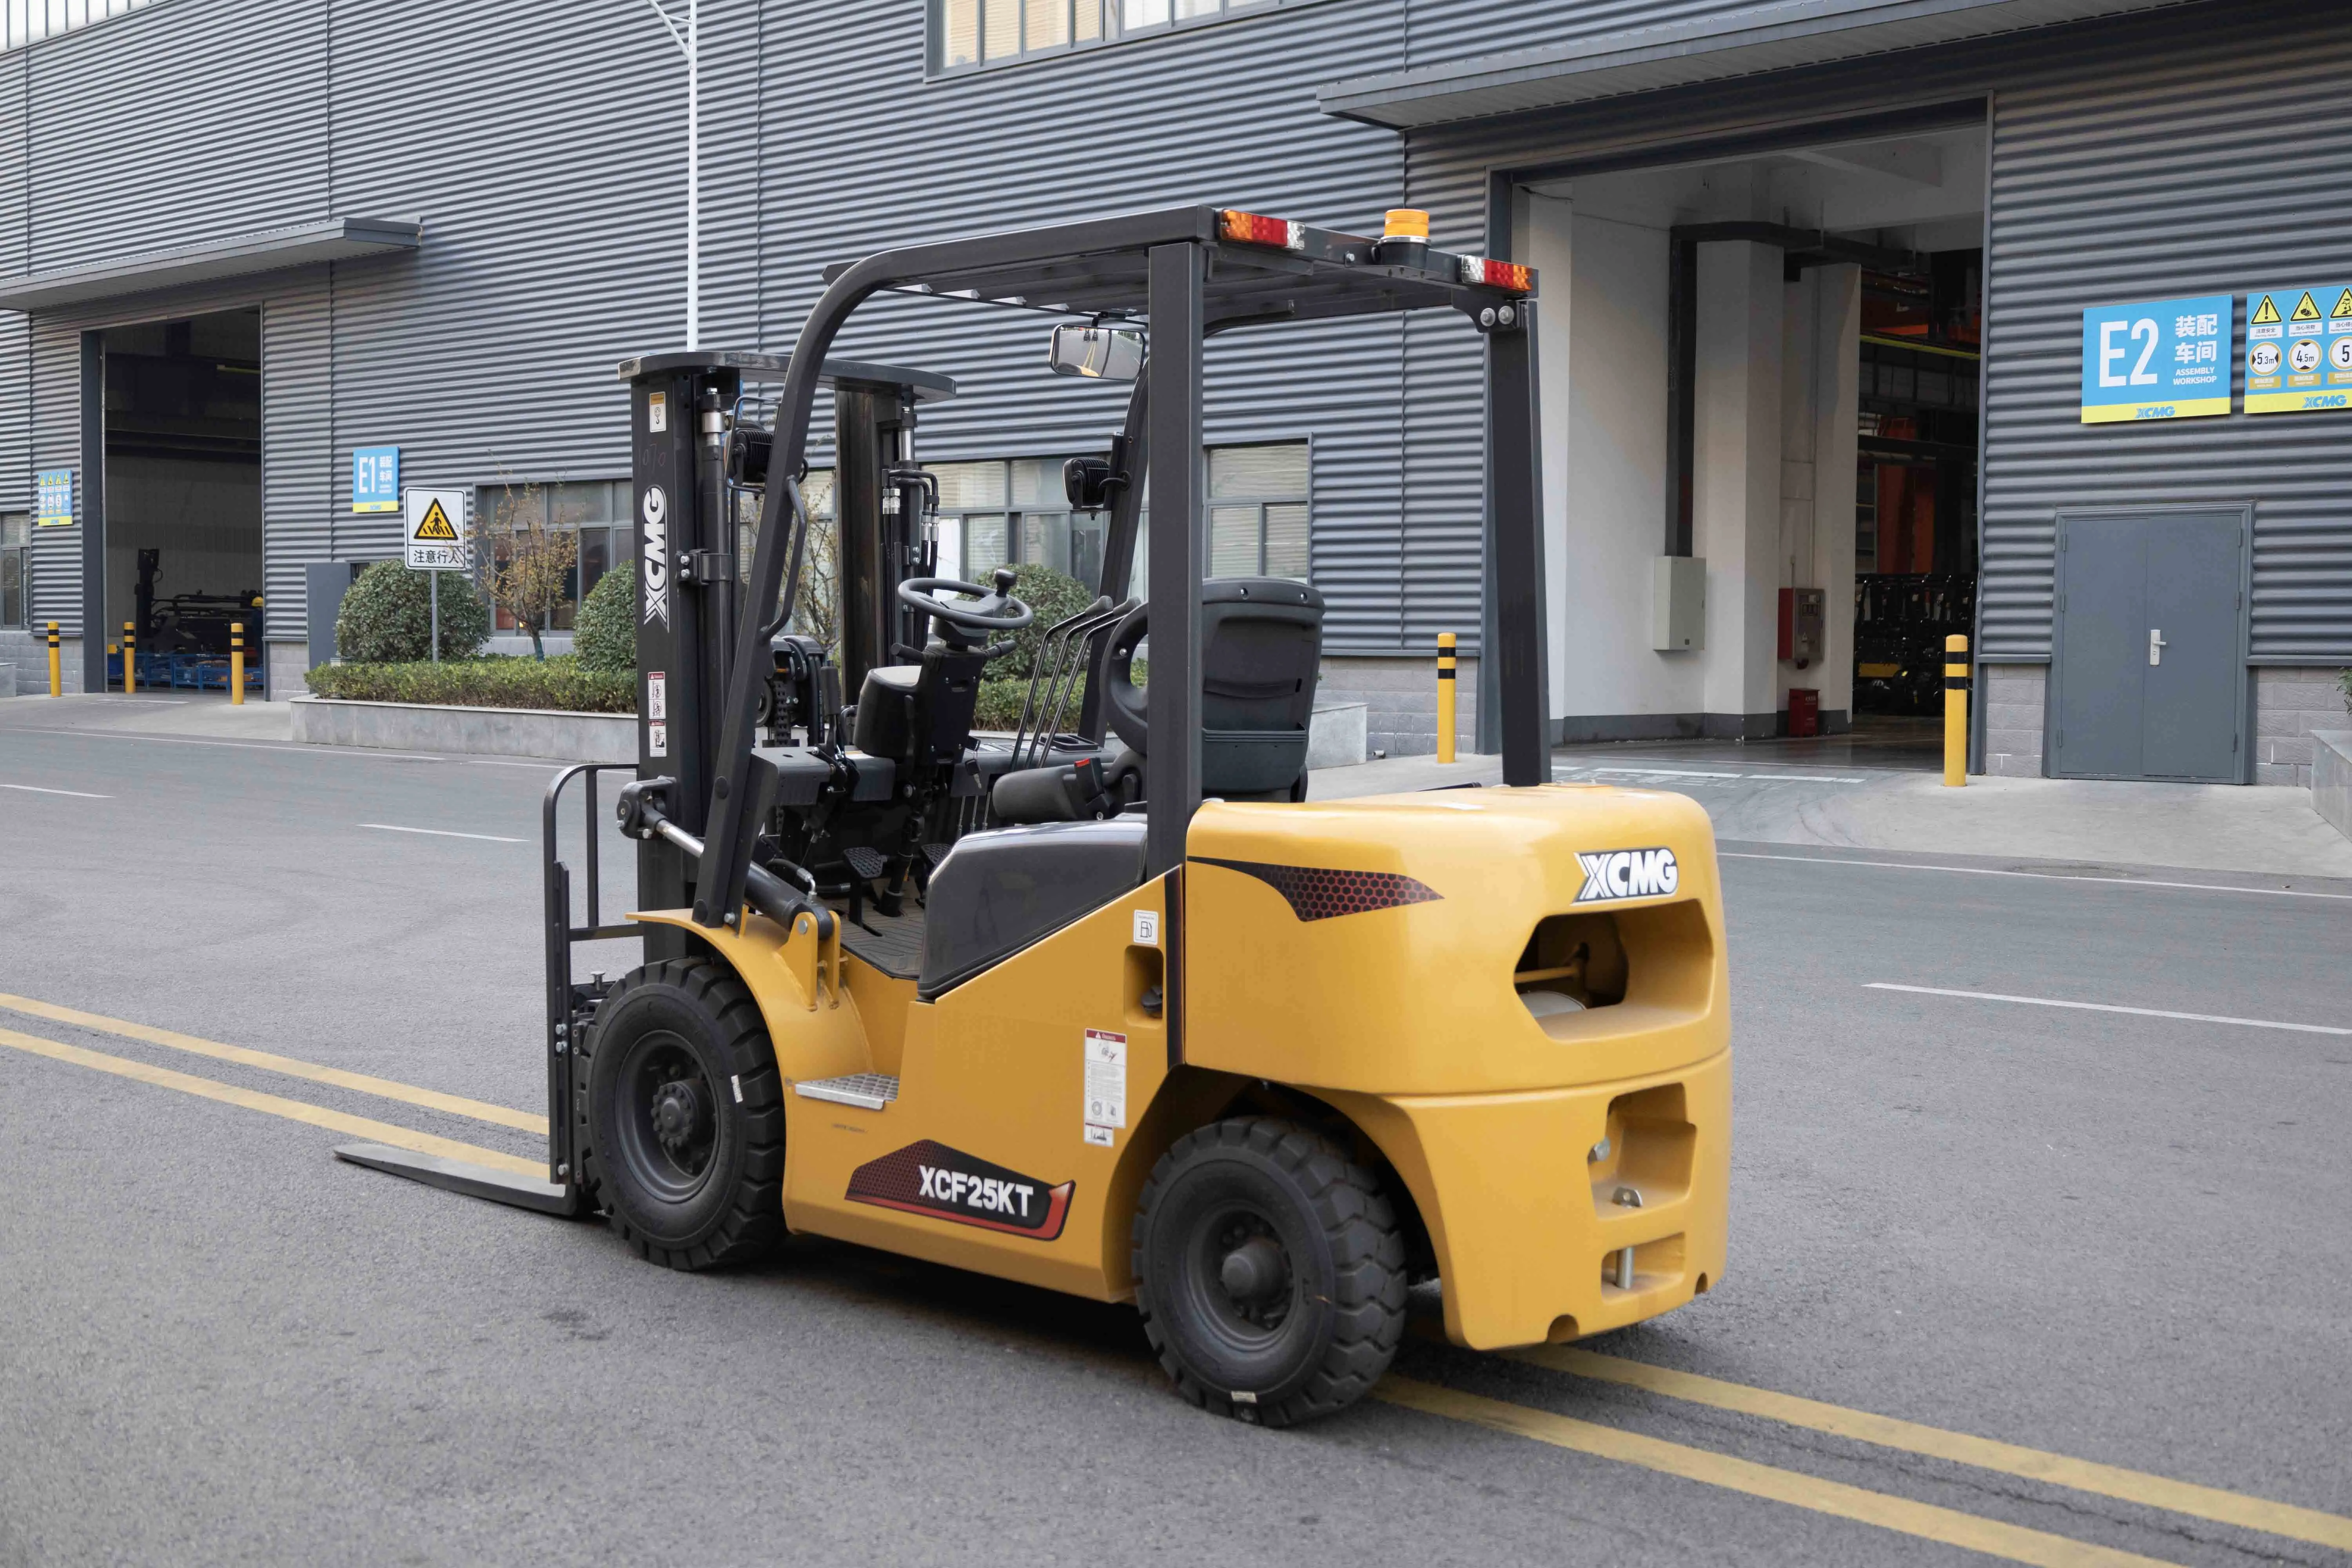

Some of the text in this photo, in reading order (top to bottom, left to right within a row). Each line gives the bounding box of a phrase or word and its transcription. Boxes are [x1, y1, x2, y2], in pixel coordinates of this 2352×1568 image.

[2175, 314, 2218, 338] 装配
[2099, 318, 2159, 387] E2
[2174, 340, 2217, 364] 车间
[2257, 352, 2274, 365] 5.3m
[2296, 350, 2314, 363] 4.5m
[2173, 376, 2217, 385] WORKSHOP
[2175, 367, 2215, 376] ASSEMBLY
[2302, 394, 2347, 408] XCMG
[2135, 405, 2175, 419] XCMG
[359, 456, 376, 493] E1
[414, 549, 459, 563] 注意行人
[643, 487, 667, 627] XCMG
[1575, 848, 1678, 901] XCMG
[919, 1165, 1034, 1217] XCF25KT
